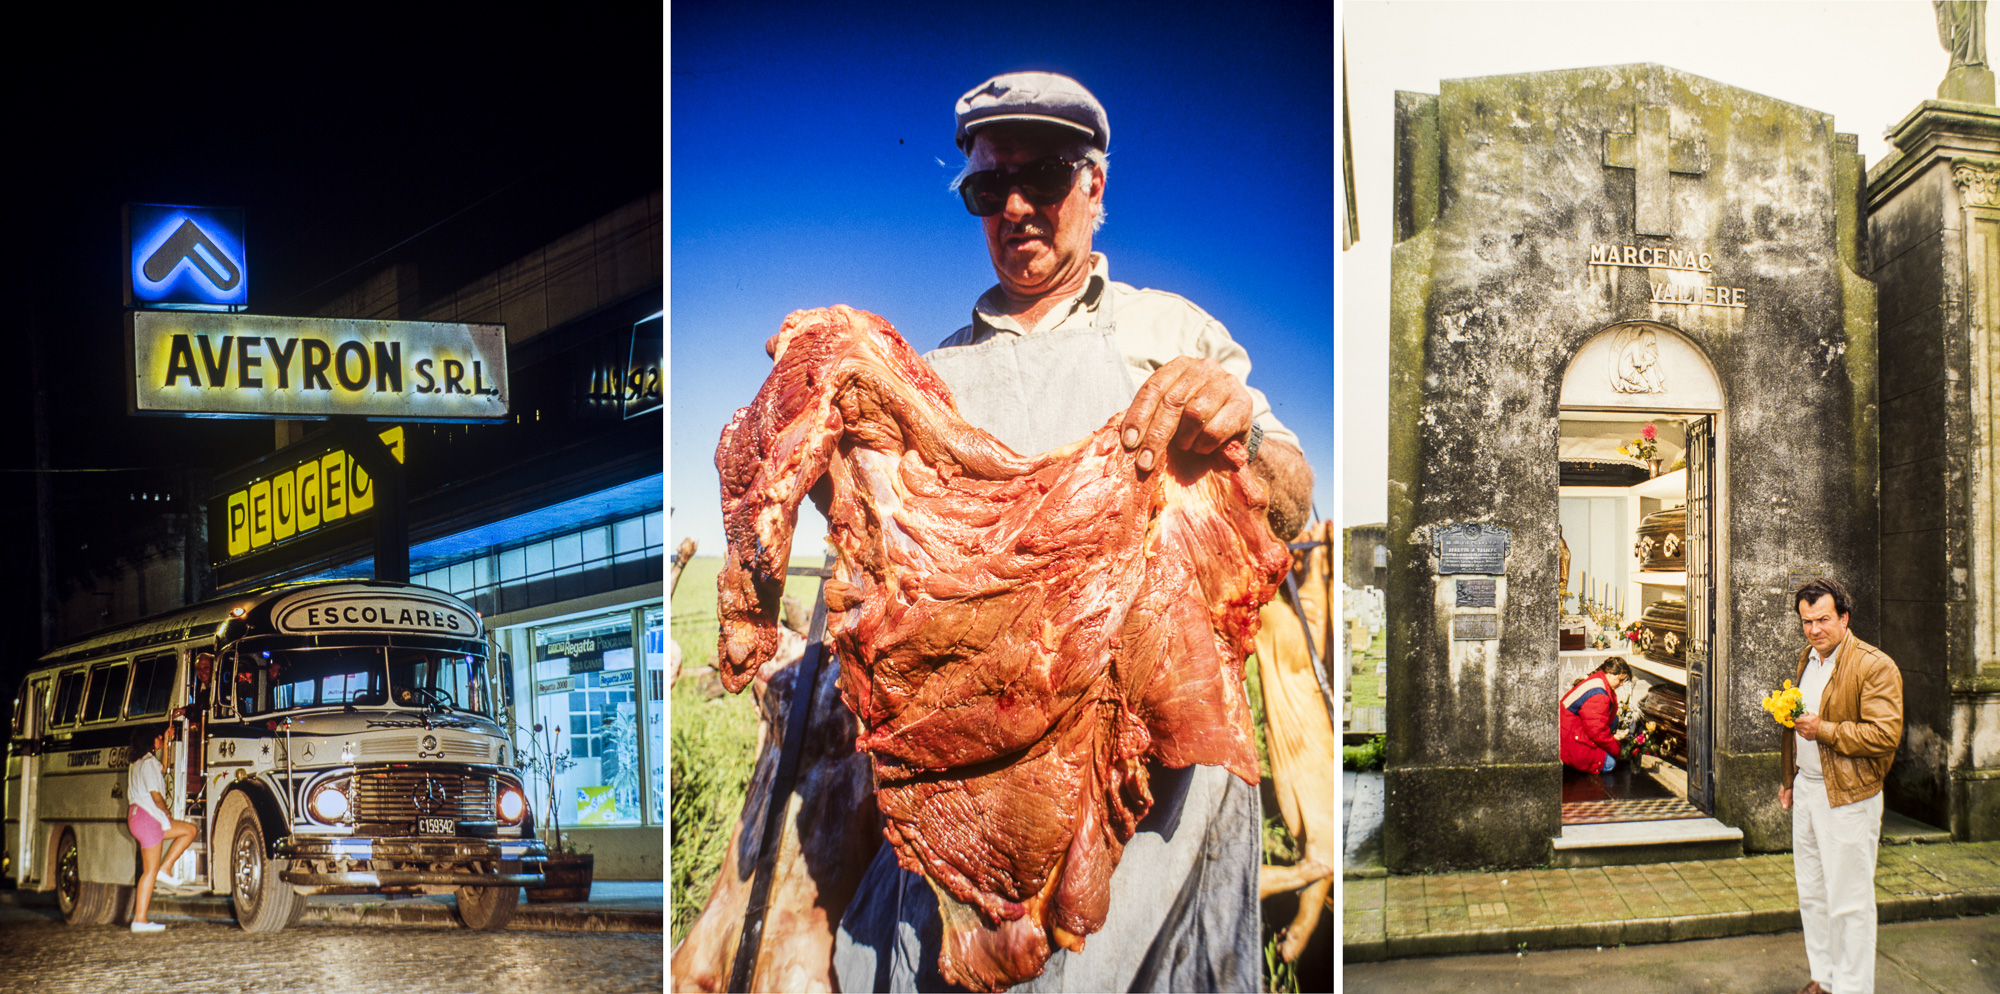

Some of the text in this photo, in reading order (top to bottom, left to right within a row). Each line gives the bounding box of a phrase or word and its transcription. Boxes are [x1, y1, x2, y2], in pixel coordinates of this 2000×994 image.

[1590, 244, 1712, 271] MARCENAC
[1650, 282, 1746, 306] VALIERE
[164, 334, 499, 396] AVEYRON S.R.L.
[308, 606, 460, 630] ESCOLARES
[565, 639, 595, 657] Regatta
[539, 680, 567, 693] Regatta 2000
[601, 672, 632, 686] Regatta 2000
[420, 819, 454, 834] C159342
